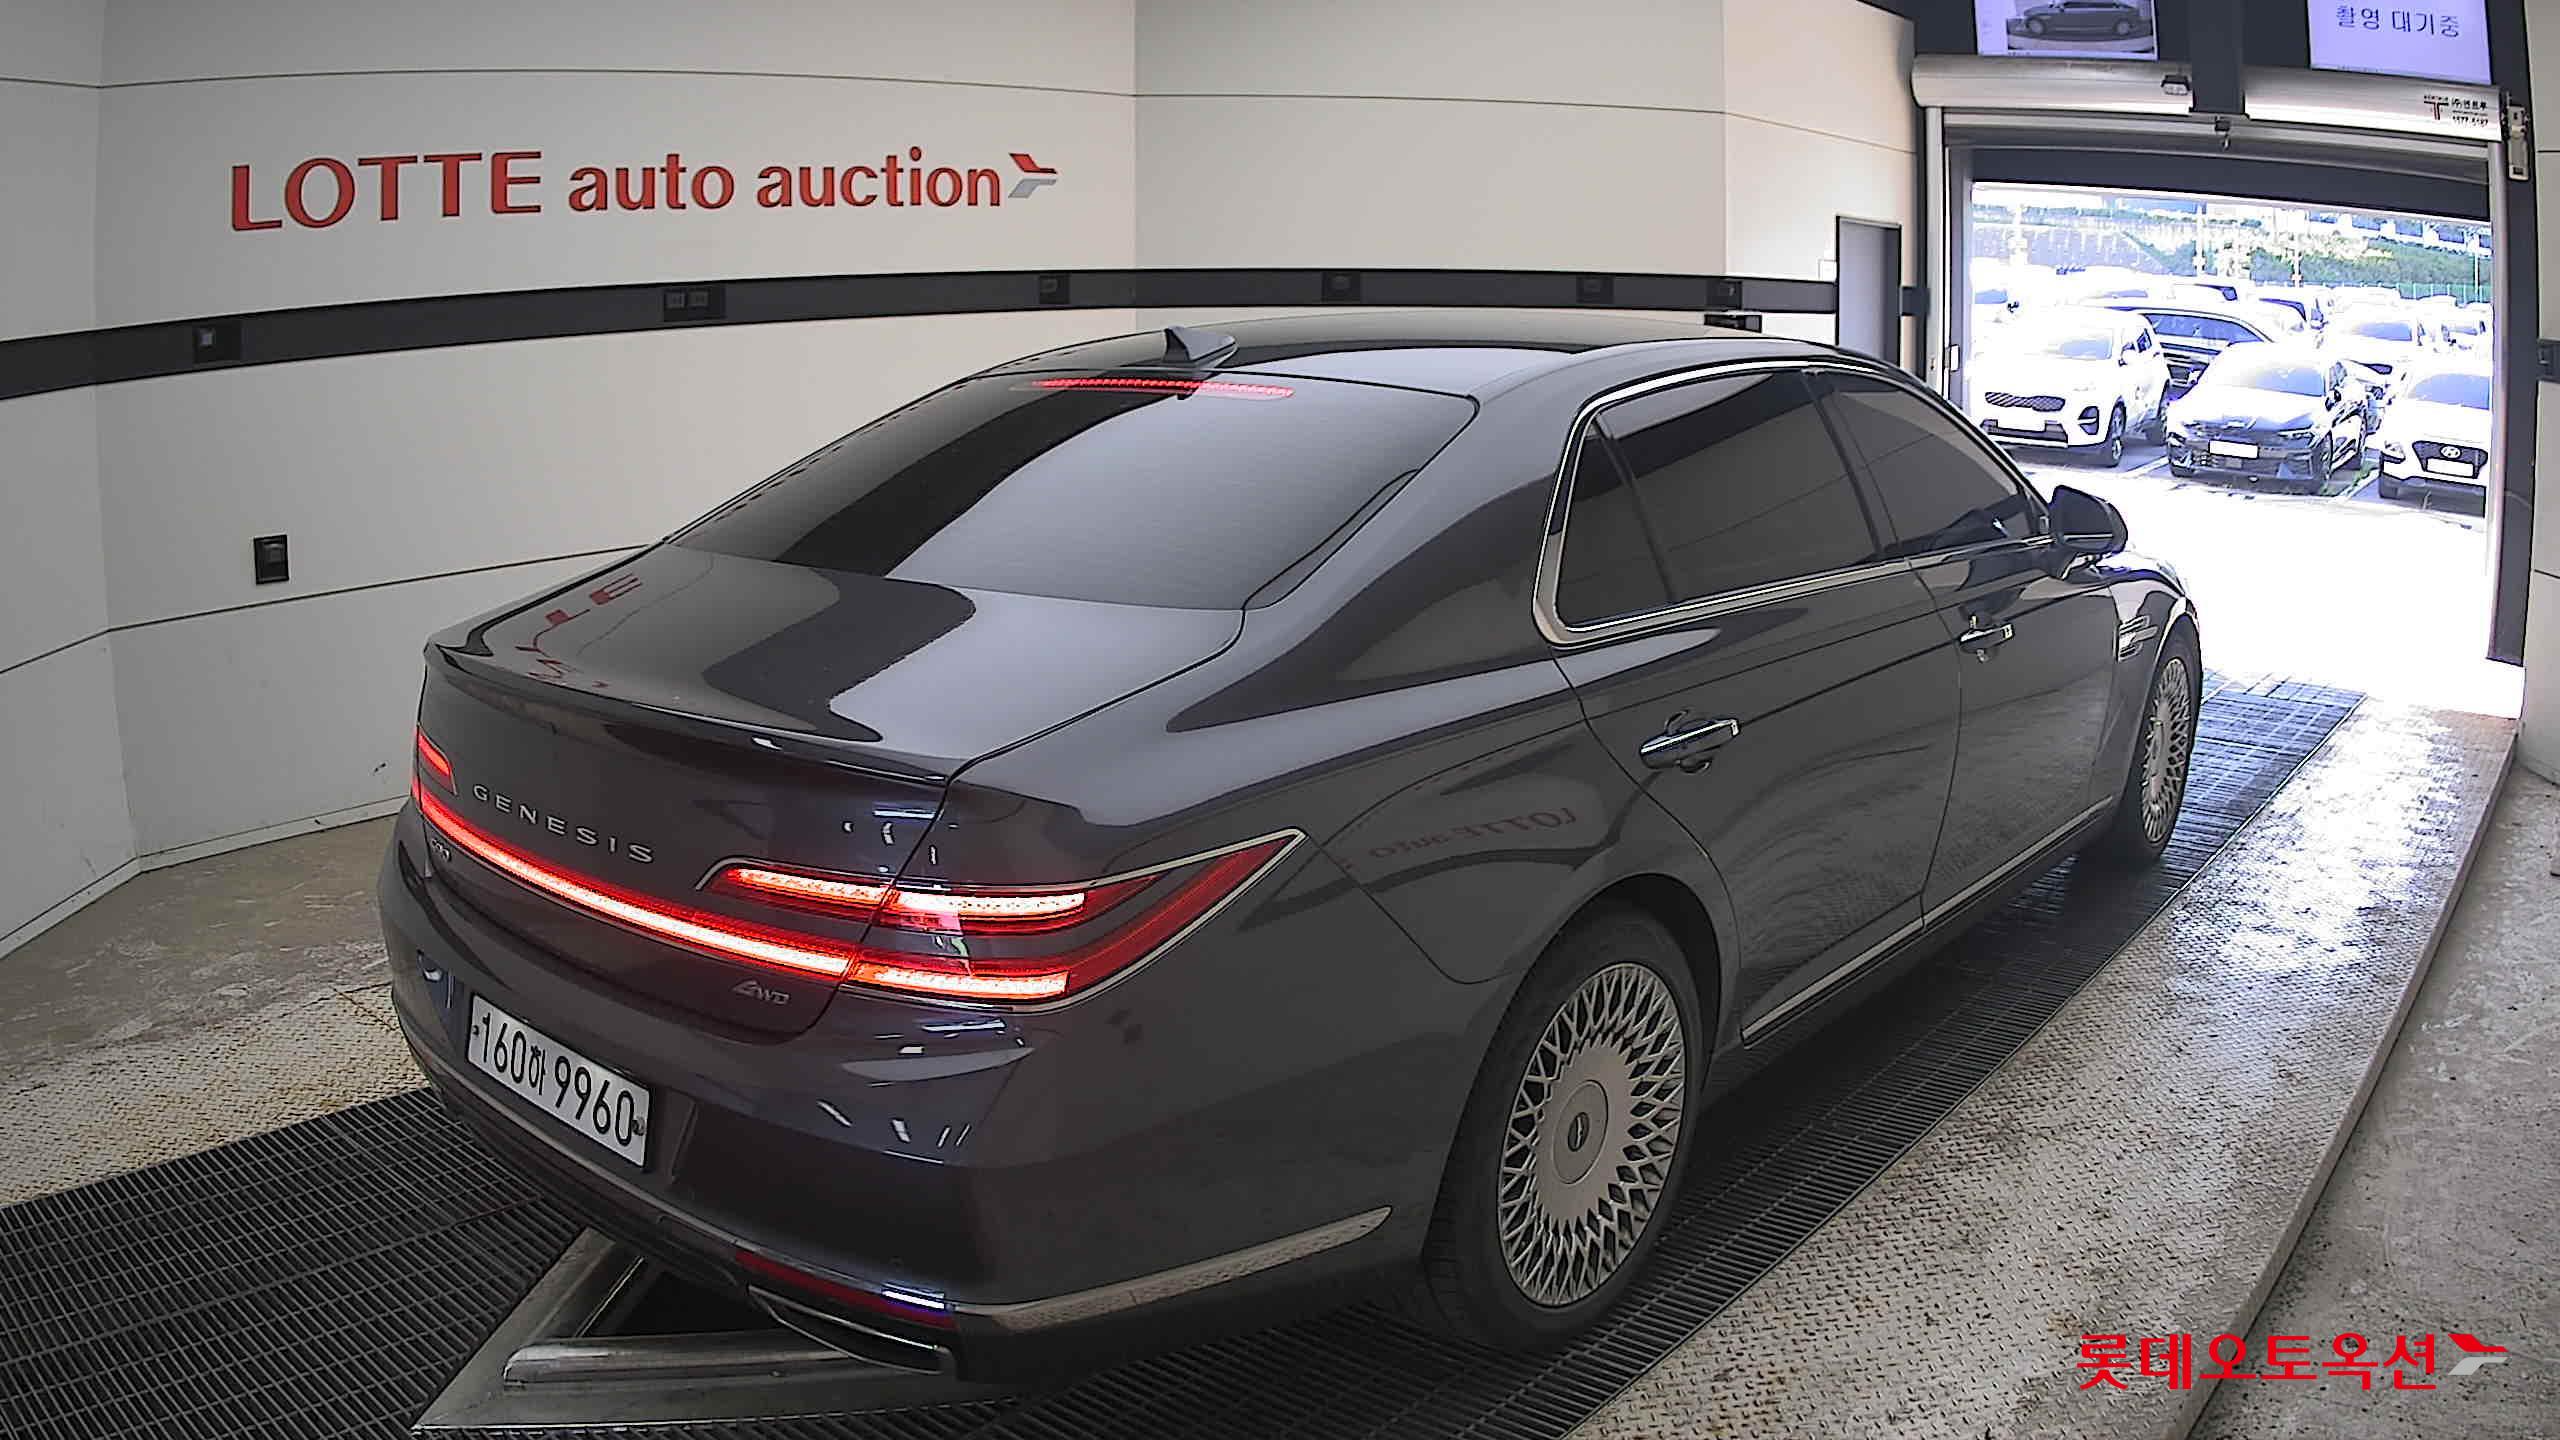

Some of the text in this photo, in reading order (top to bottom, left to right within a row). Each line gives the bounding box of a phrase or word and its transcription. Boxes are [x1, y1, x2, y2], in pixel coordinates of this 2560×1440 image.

[2336, 5, 2460, 38] 촬영 대기중
[231, 146, 1002, 232] LOTTE auto auction
[472, 784, 655, 864] GENESIS
[482, 1012, 635, 1147] 160하 9960
